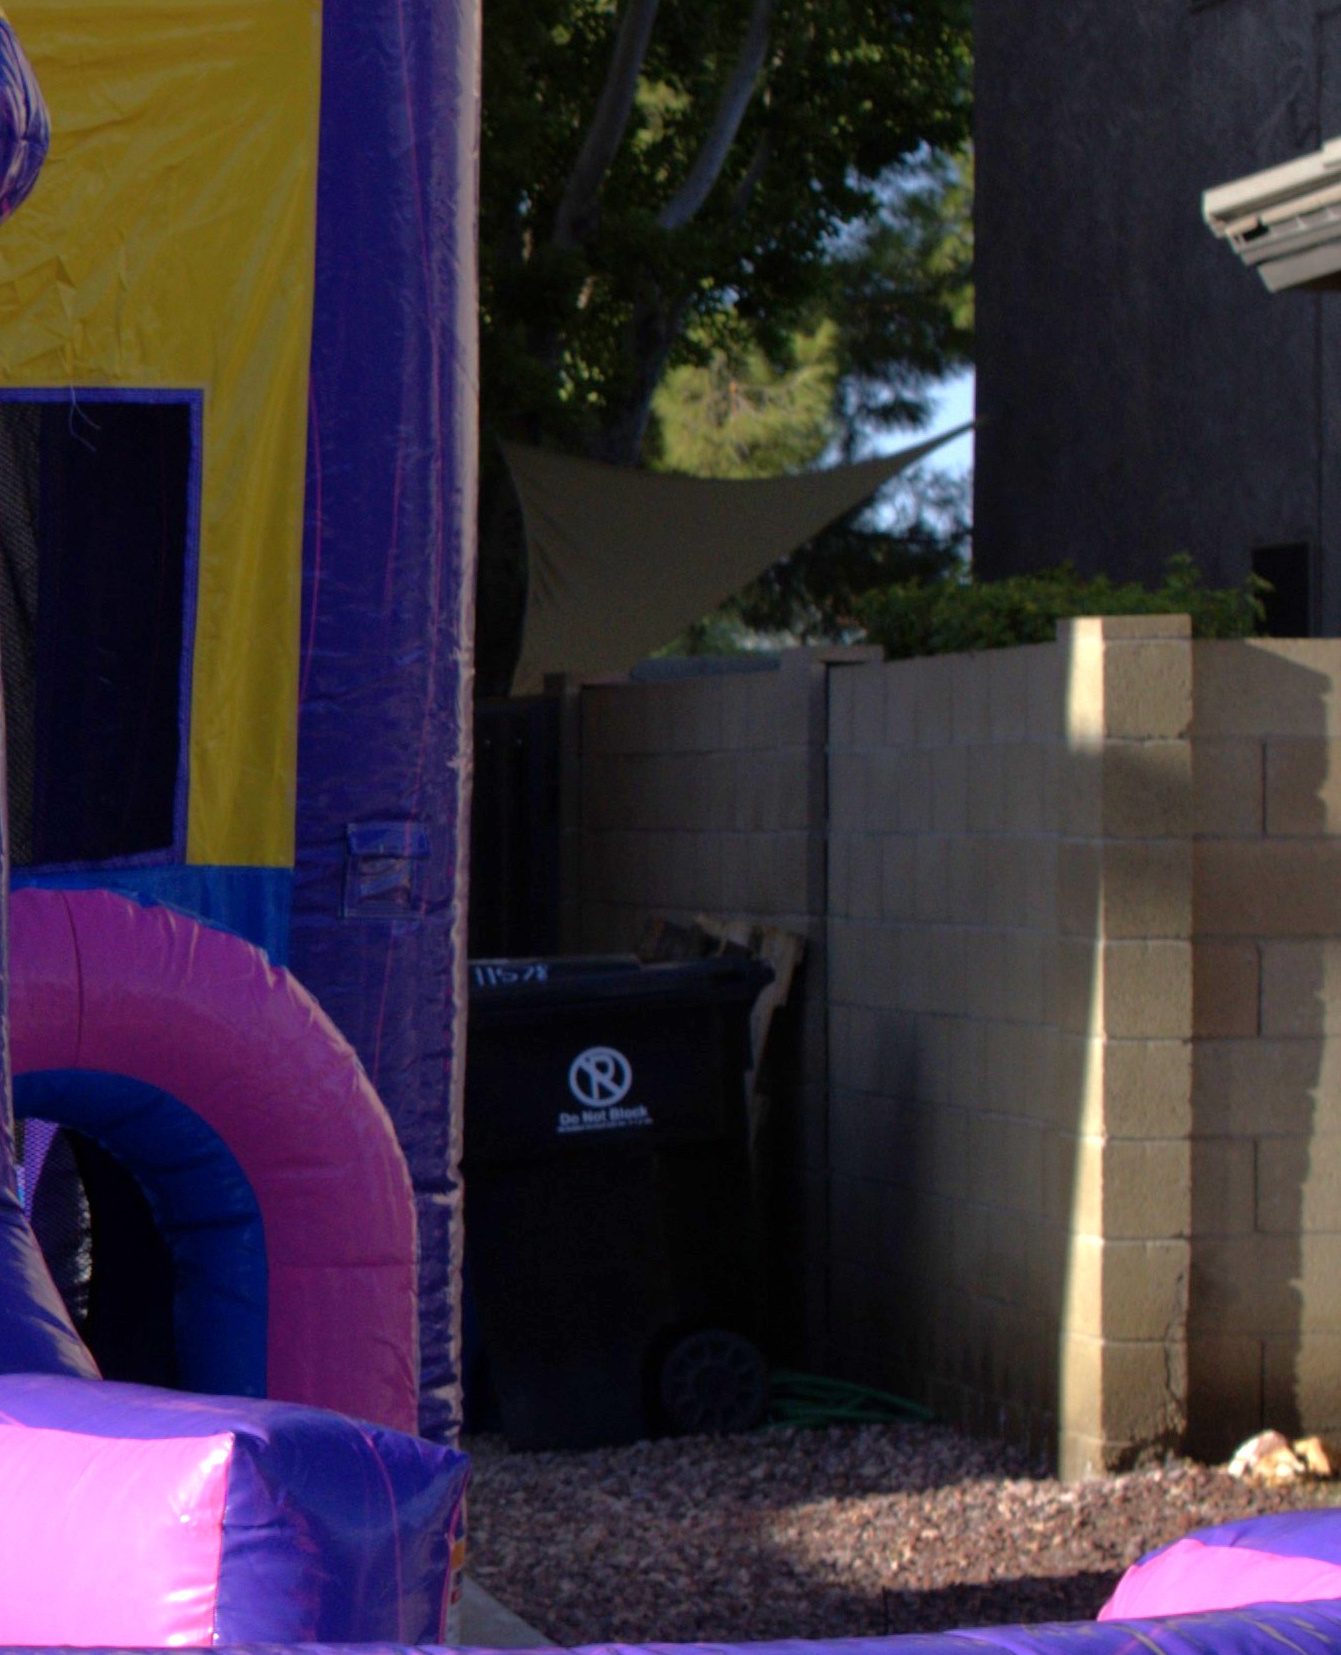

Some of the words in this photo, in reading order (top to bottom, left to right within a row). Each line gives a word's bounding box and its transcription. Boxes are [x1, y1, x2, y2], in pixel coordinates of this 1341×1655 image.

[559, 1112, 580, 1125] Do
[582, 1109, 607, 1123] Not
[609, 1105, 648, 1121] Block
